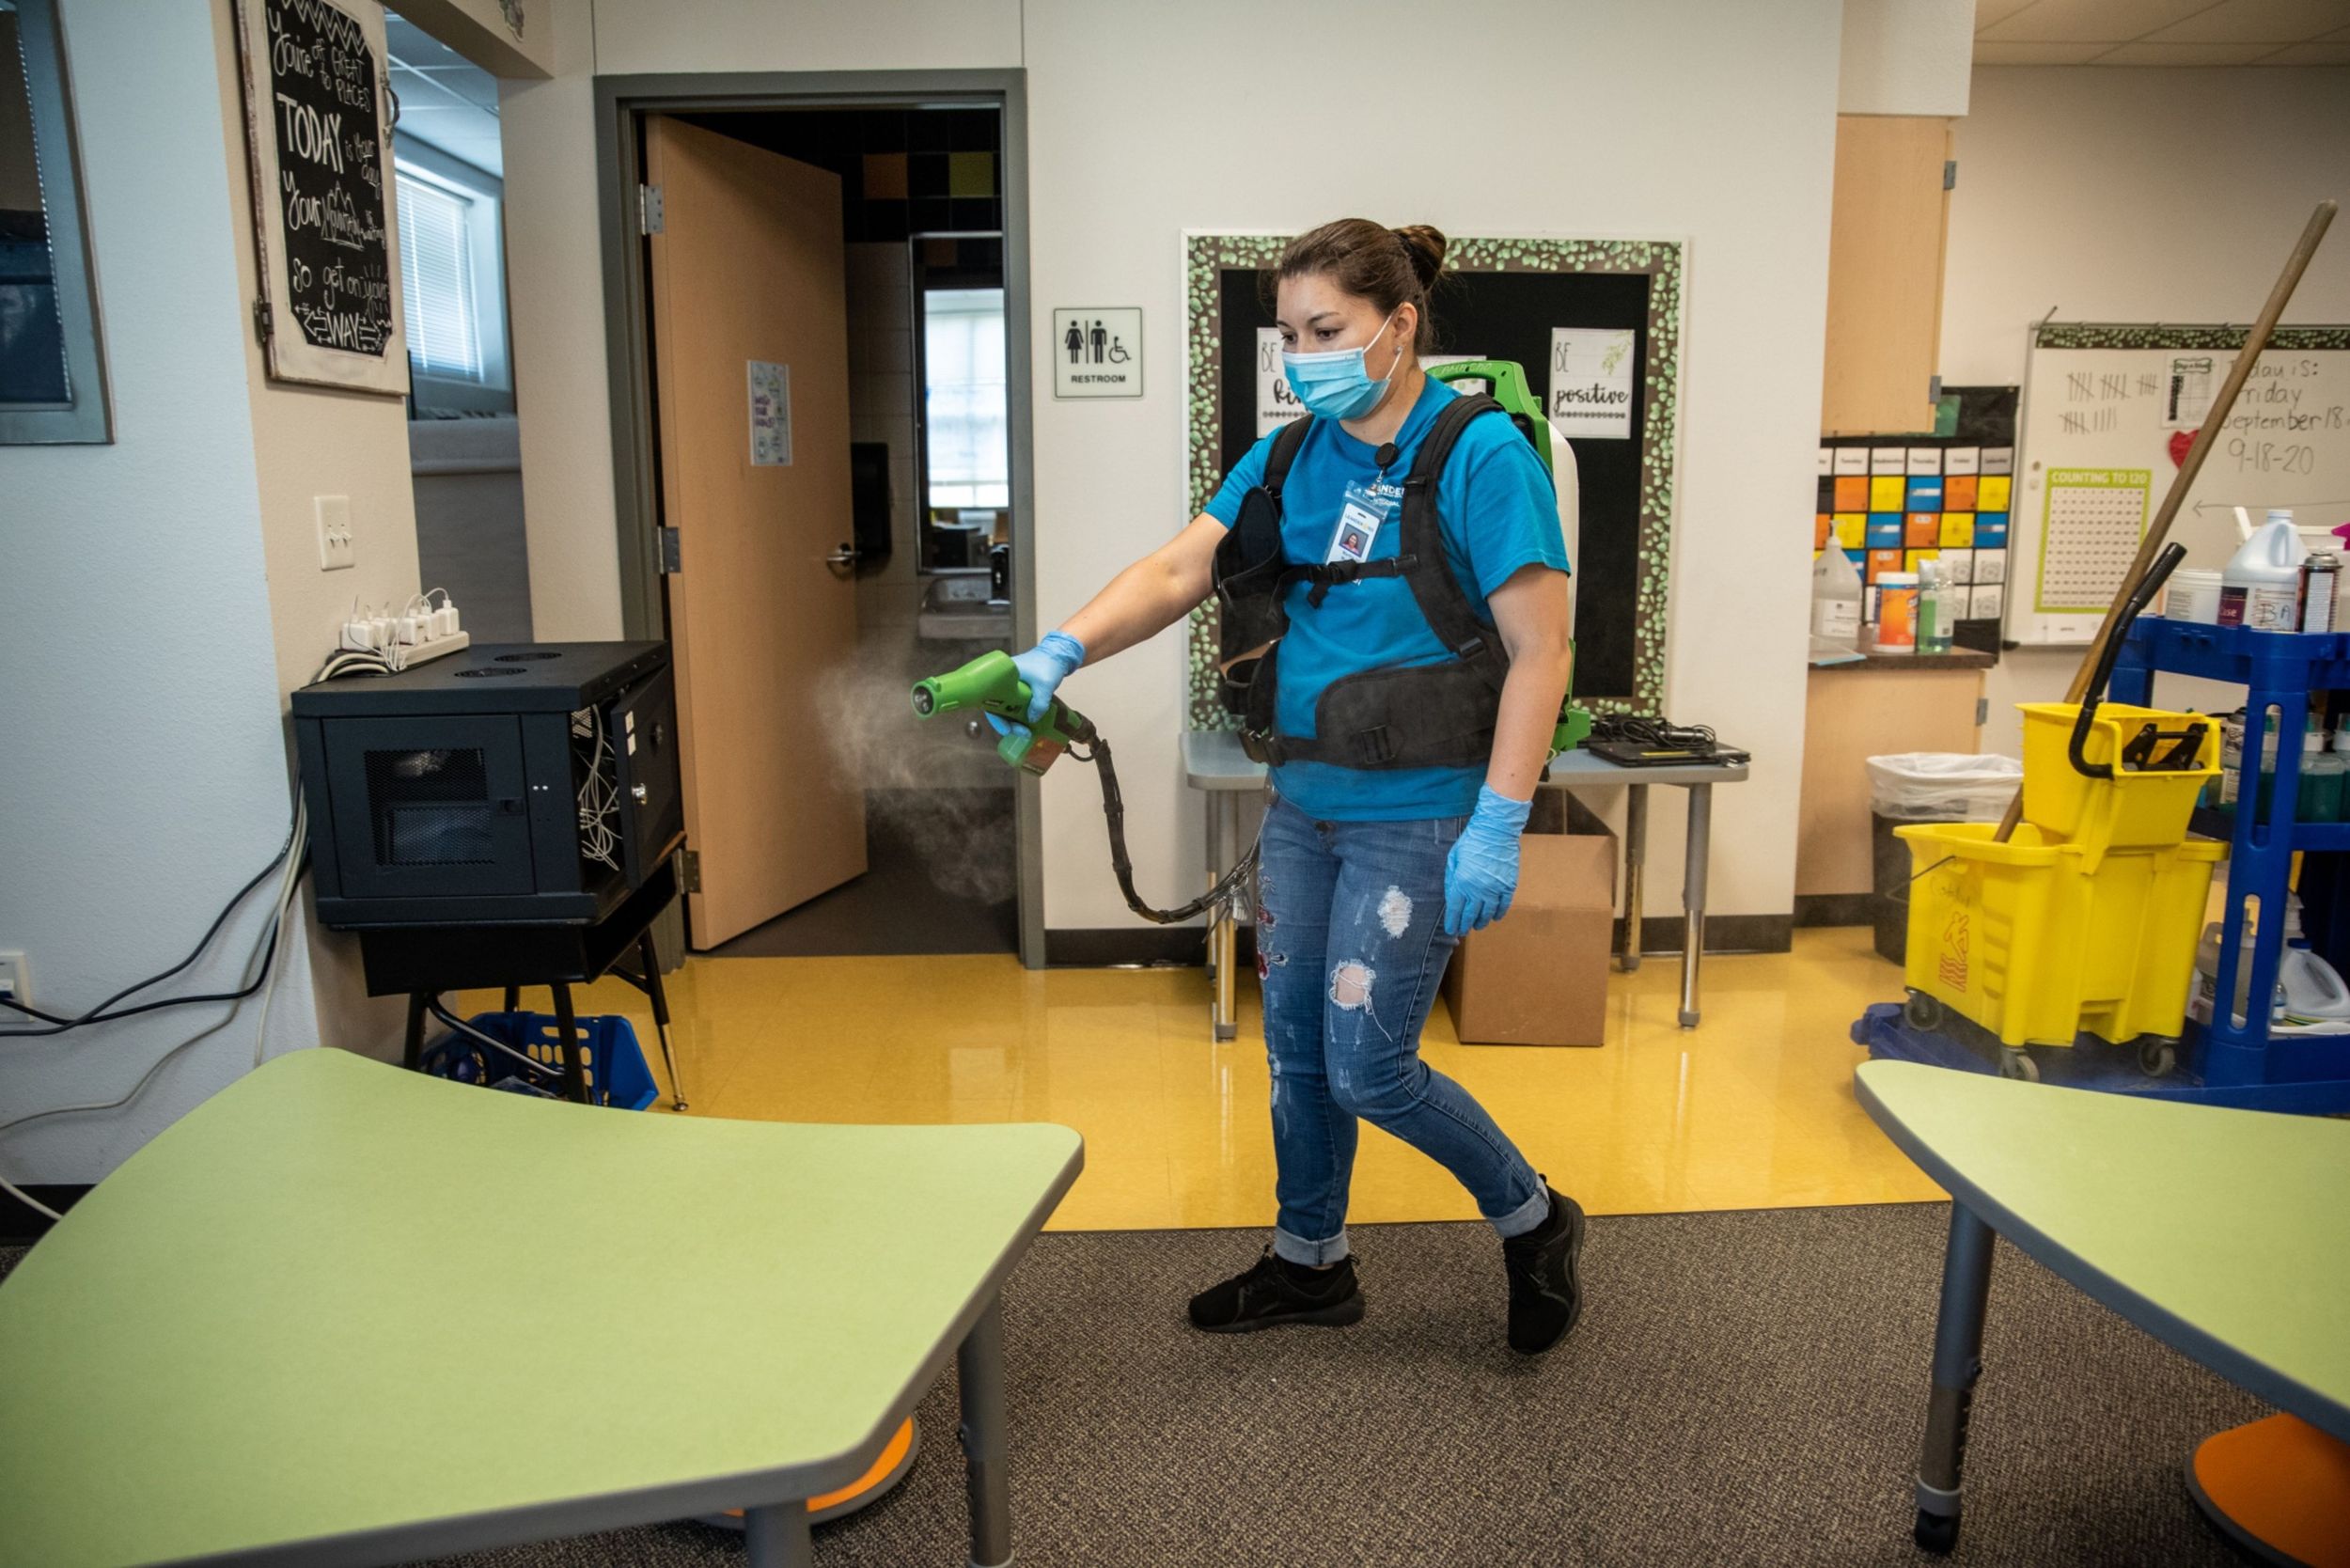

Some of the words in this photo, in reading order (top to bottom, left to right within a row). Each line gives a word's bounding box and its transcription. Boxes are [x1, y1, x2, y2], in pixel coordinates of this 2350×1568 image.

[275, 92, 344, 175] TODAY
[322, 257, 344, 310] get
[326, 311, 361, 351] WAY
[1261, 341, 1277, 373] BE
[1555, 341, 1572, 373] BE
[1070, 374, 1127, 384] RESTROOM
[1553, 383, 1629, 414] positive
[2227, 437, 2315, 476] 9-18-20
[2052, 471, 2109, 484] COUNTING
[2112, 472, 2127, 484] TO
[2129, 473, 2148, 485] 120
